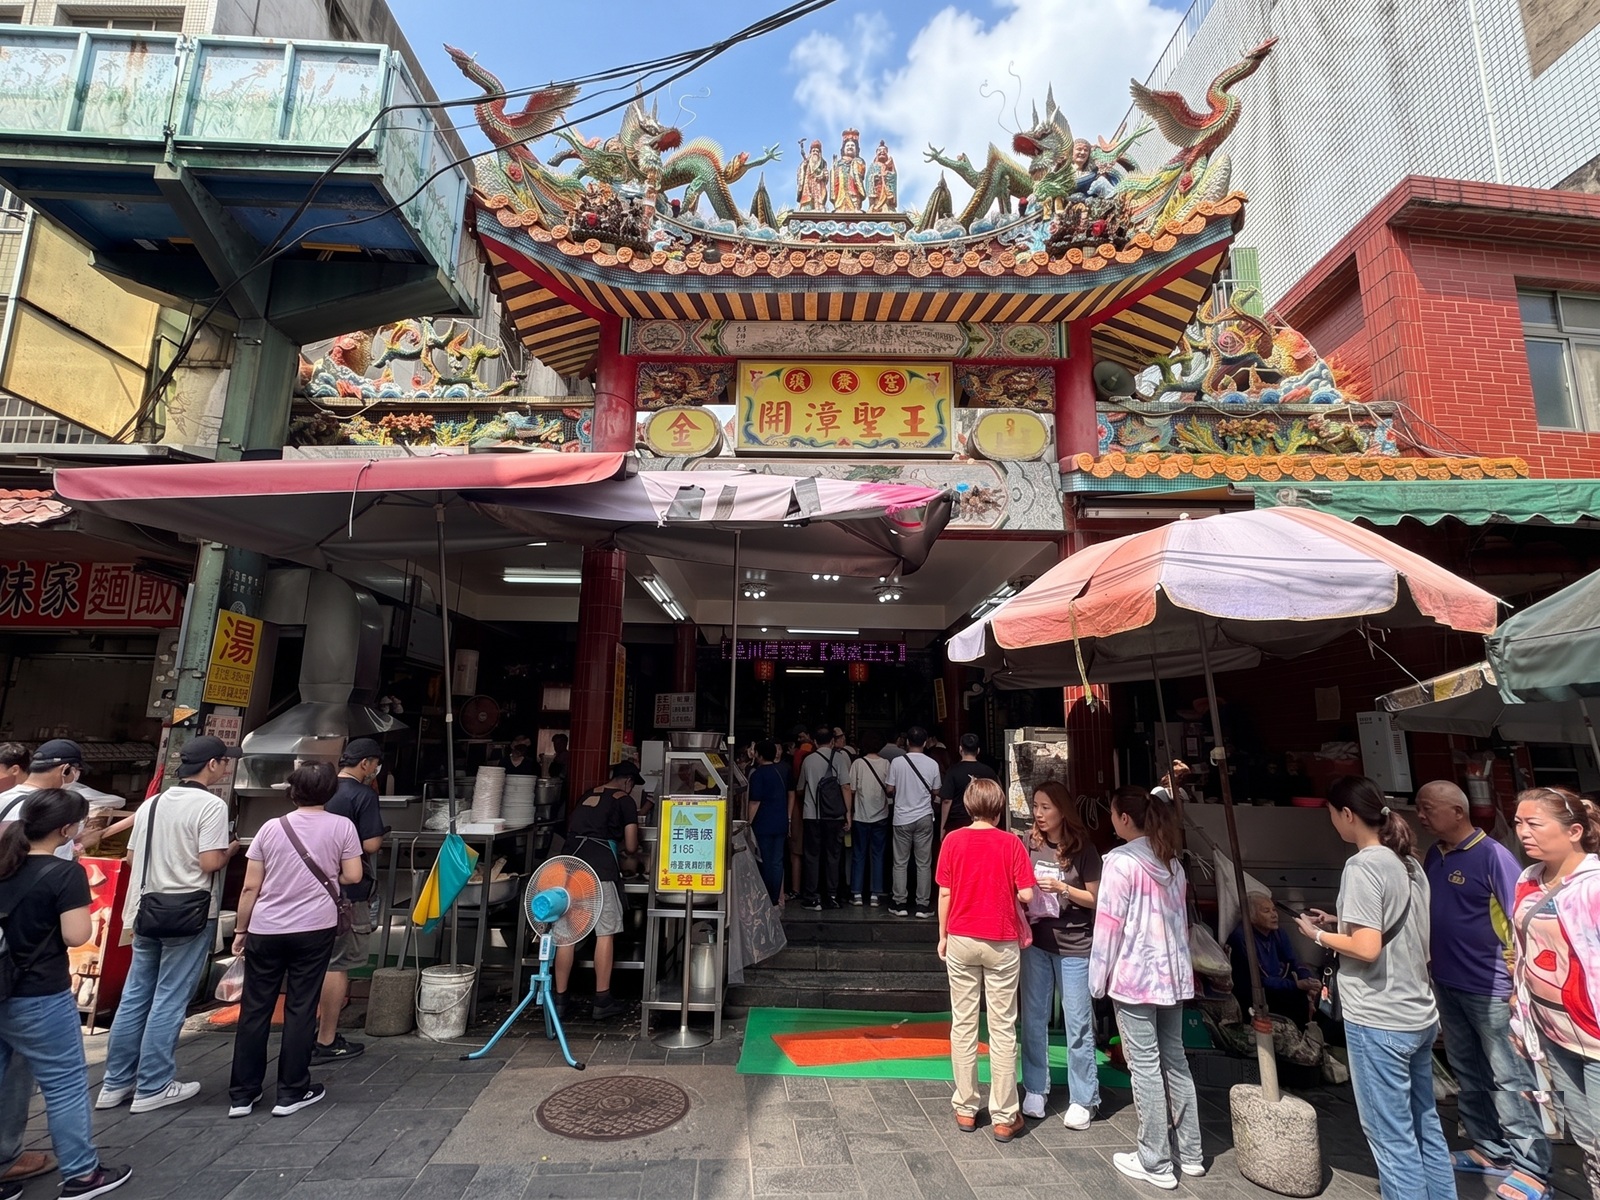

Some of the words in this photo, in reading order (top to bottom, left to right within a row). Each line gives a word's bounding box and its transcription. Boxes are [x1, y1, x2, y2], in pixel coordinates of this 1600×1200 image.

[666, 412, 702, 447] 金
[759, 401, 930, 438] 開漳聖王
[219, 616, 256, 665] 湯
